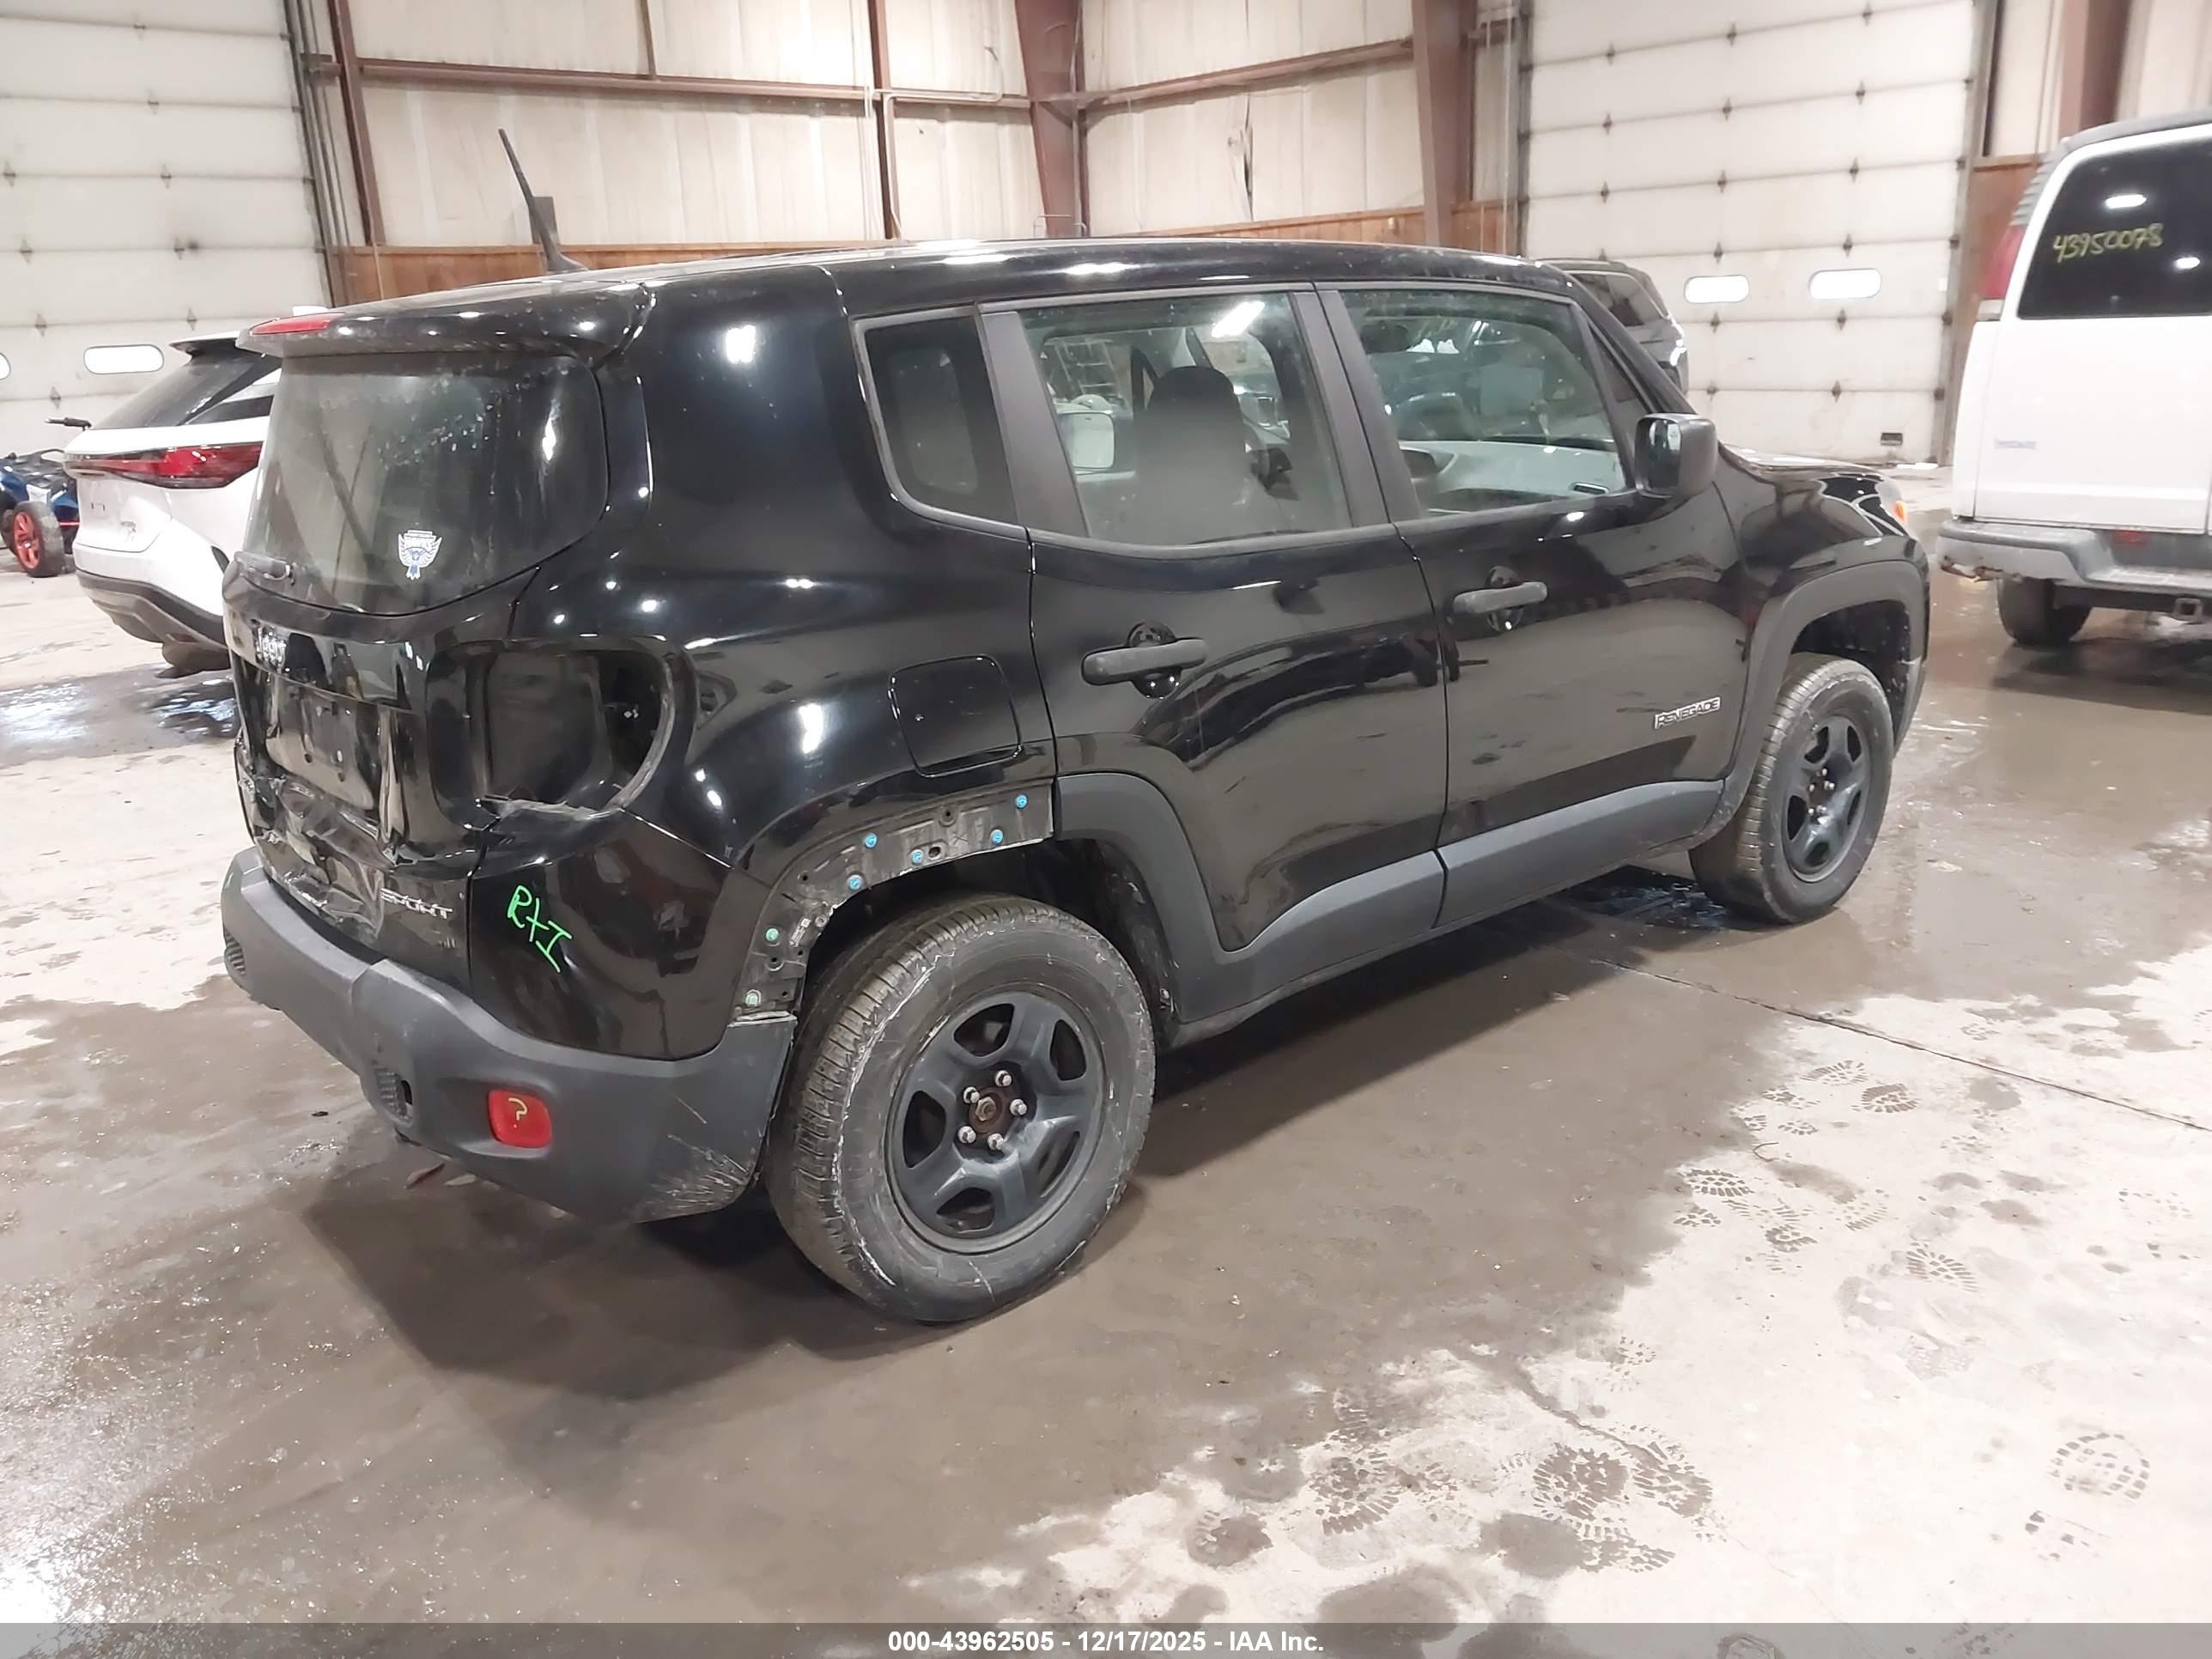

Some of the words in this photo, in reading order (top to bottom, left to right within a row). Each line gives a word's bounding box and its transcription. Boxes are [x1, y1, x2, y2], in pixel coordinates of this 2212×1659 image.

[2053, 222, 2164, 263] 43950078
[1654, 696, 1721, 729] RENEGADE
[380, 888, 453, 919] SPORT
